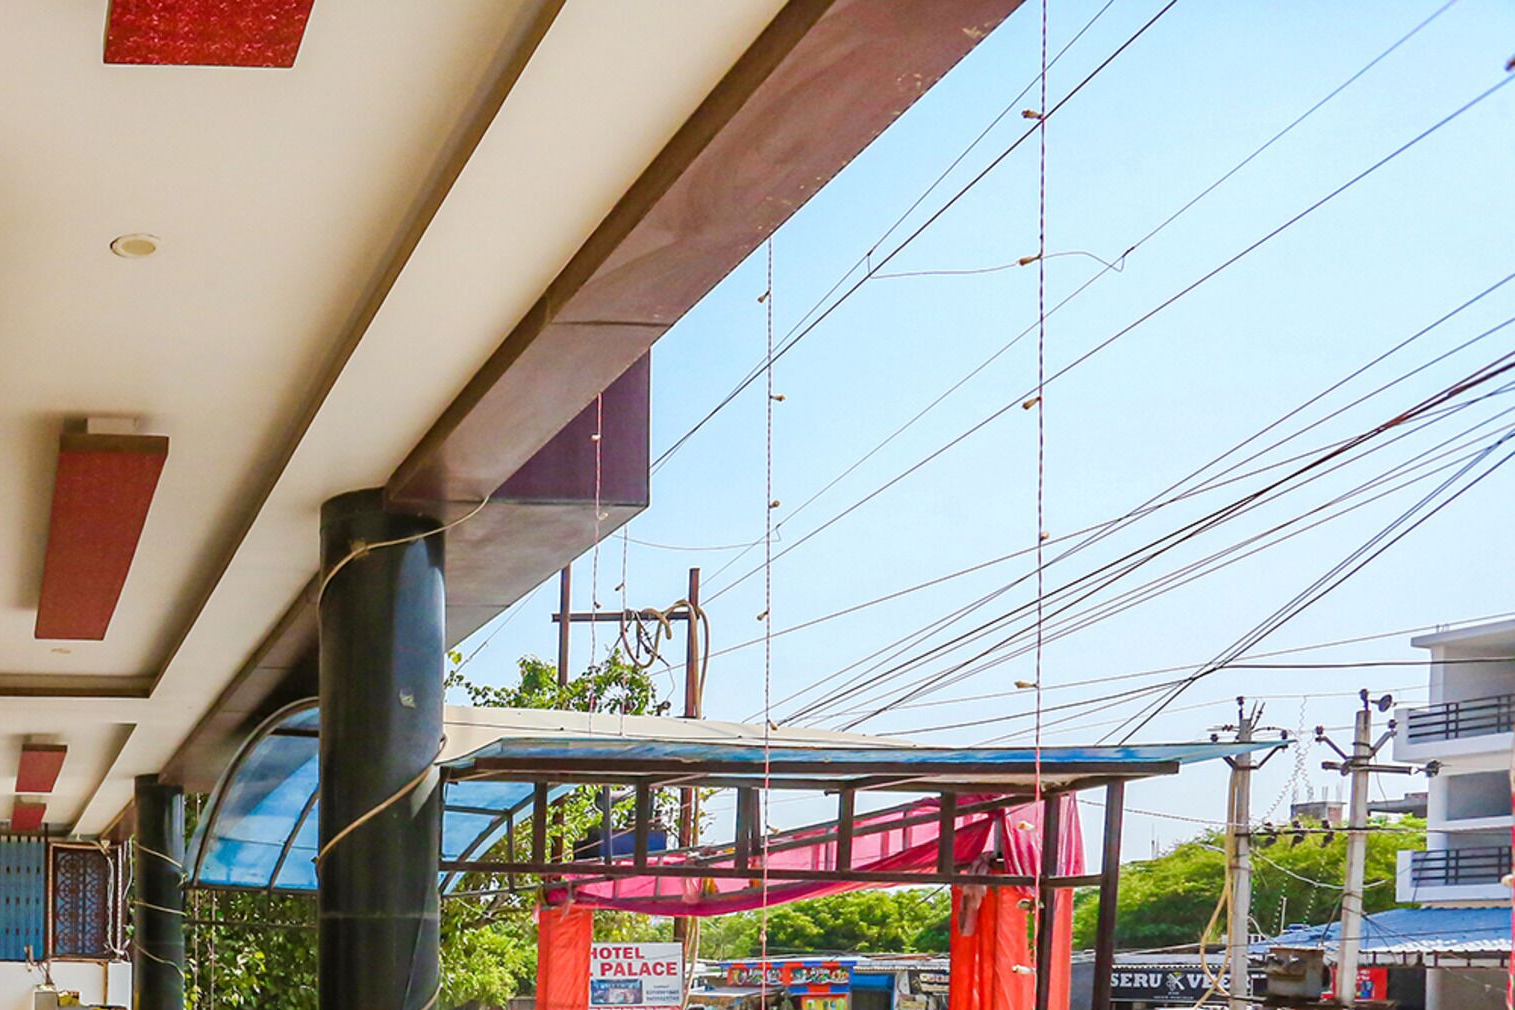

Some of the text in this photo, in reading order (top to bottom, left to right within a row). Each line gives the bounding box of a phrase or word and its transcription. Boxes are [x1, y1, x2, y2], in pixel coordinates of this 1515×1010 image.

[600, 962, 677, 976] PALACE
[1110, 973, 1251, 989] SERU VEE
